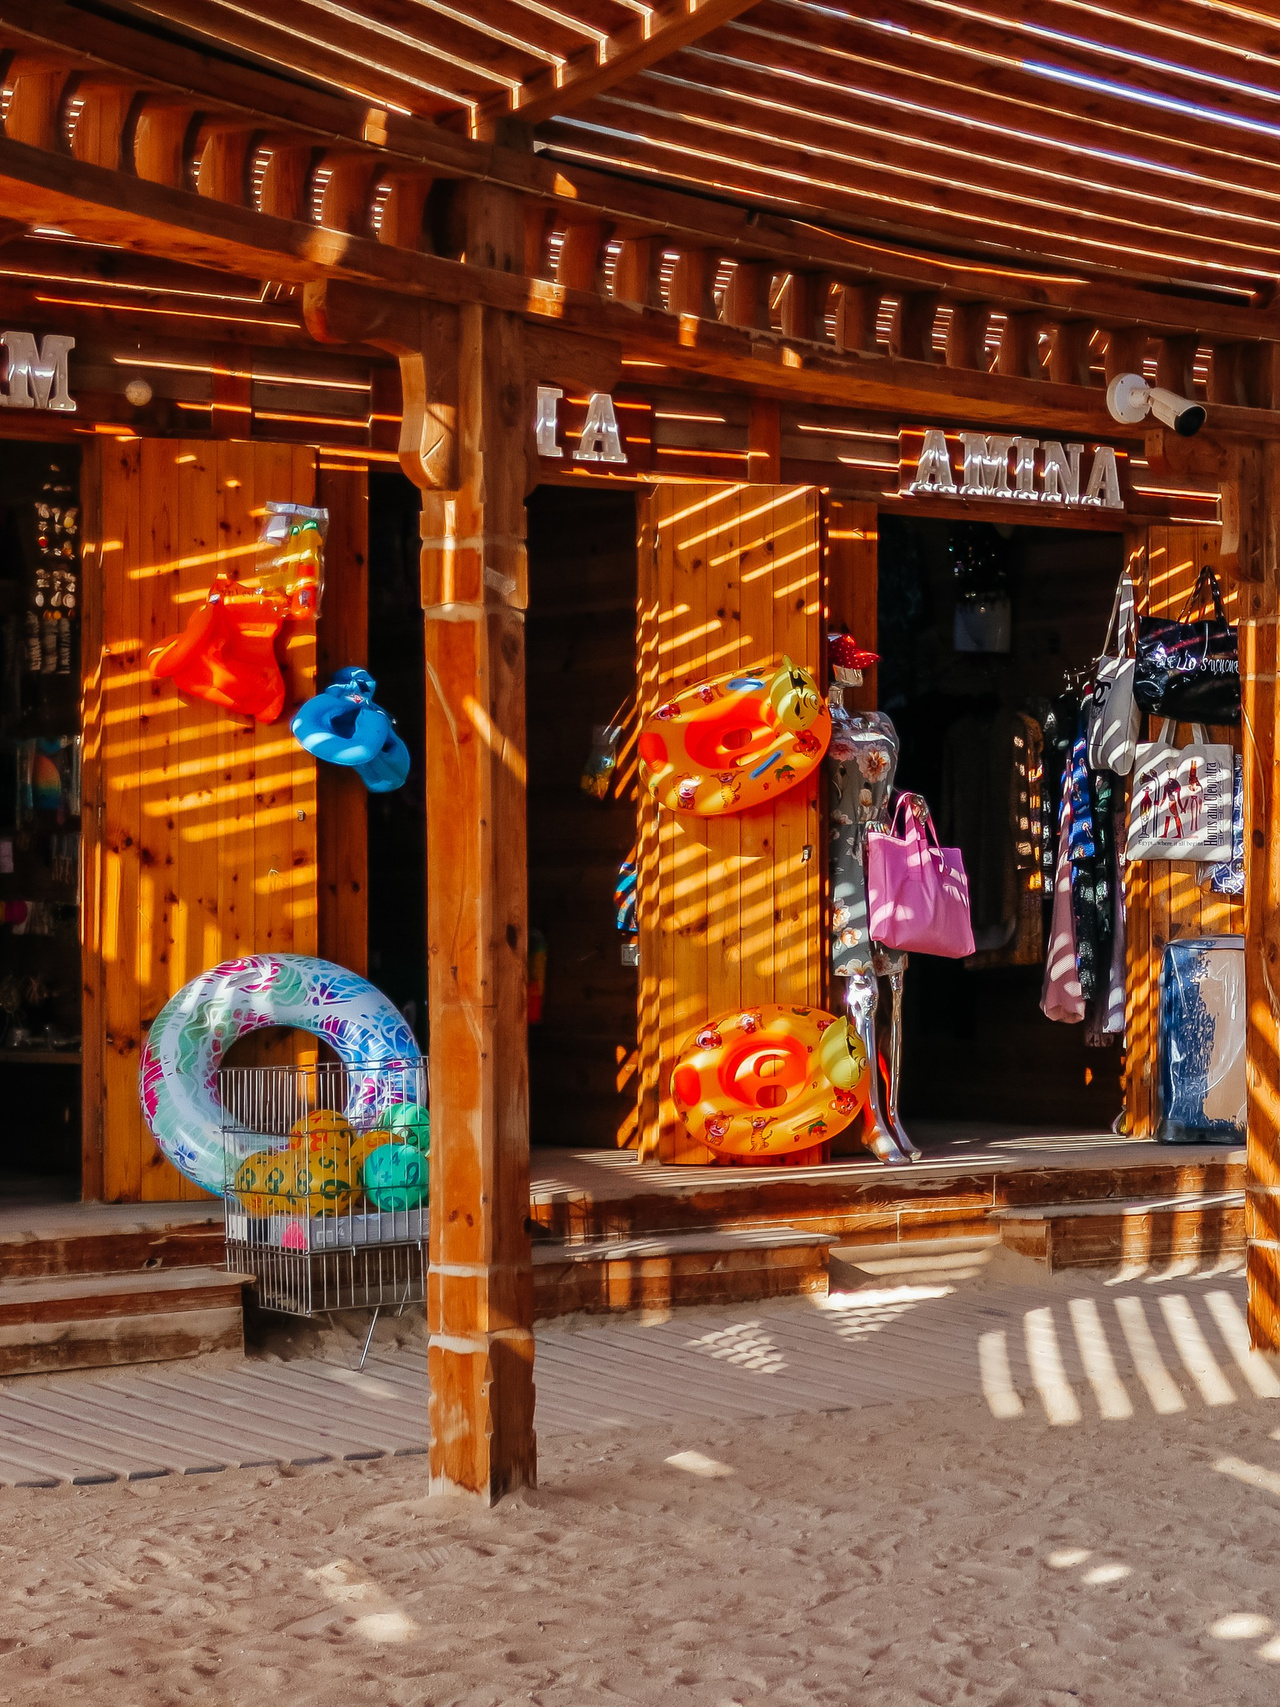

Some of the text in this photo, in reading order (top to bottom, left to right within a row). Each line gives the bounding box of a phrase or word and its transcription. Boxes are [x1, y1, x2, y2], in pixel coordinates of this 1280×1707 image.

[908, 429, 1125, 510] AMINA
[1203, 762, 1219, 846] Horus and Cleopatra
